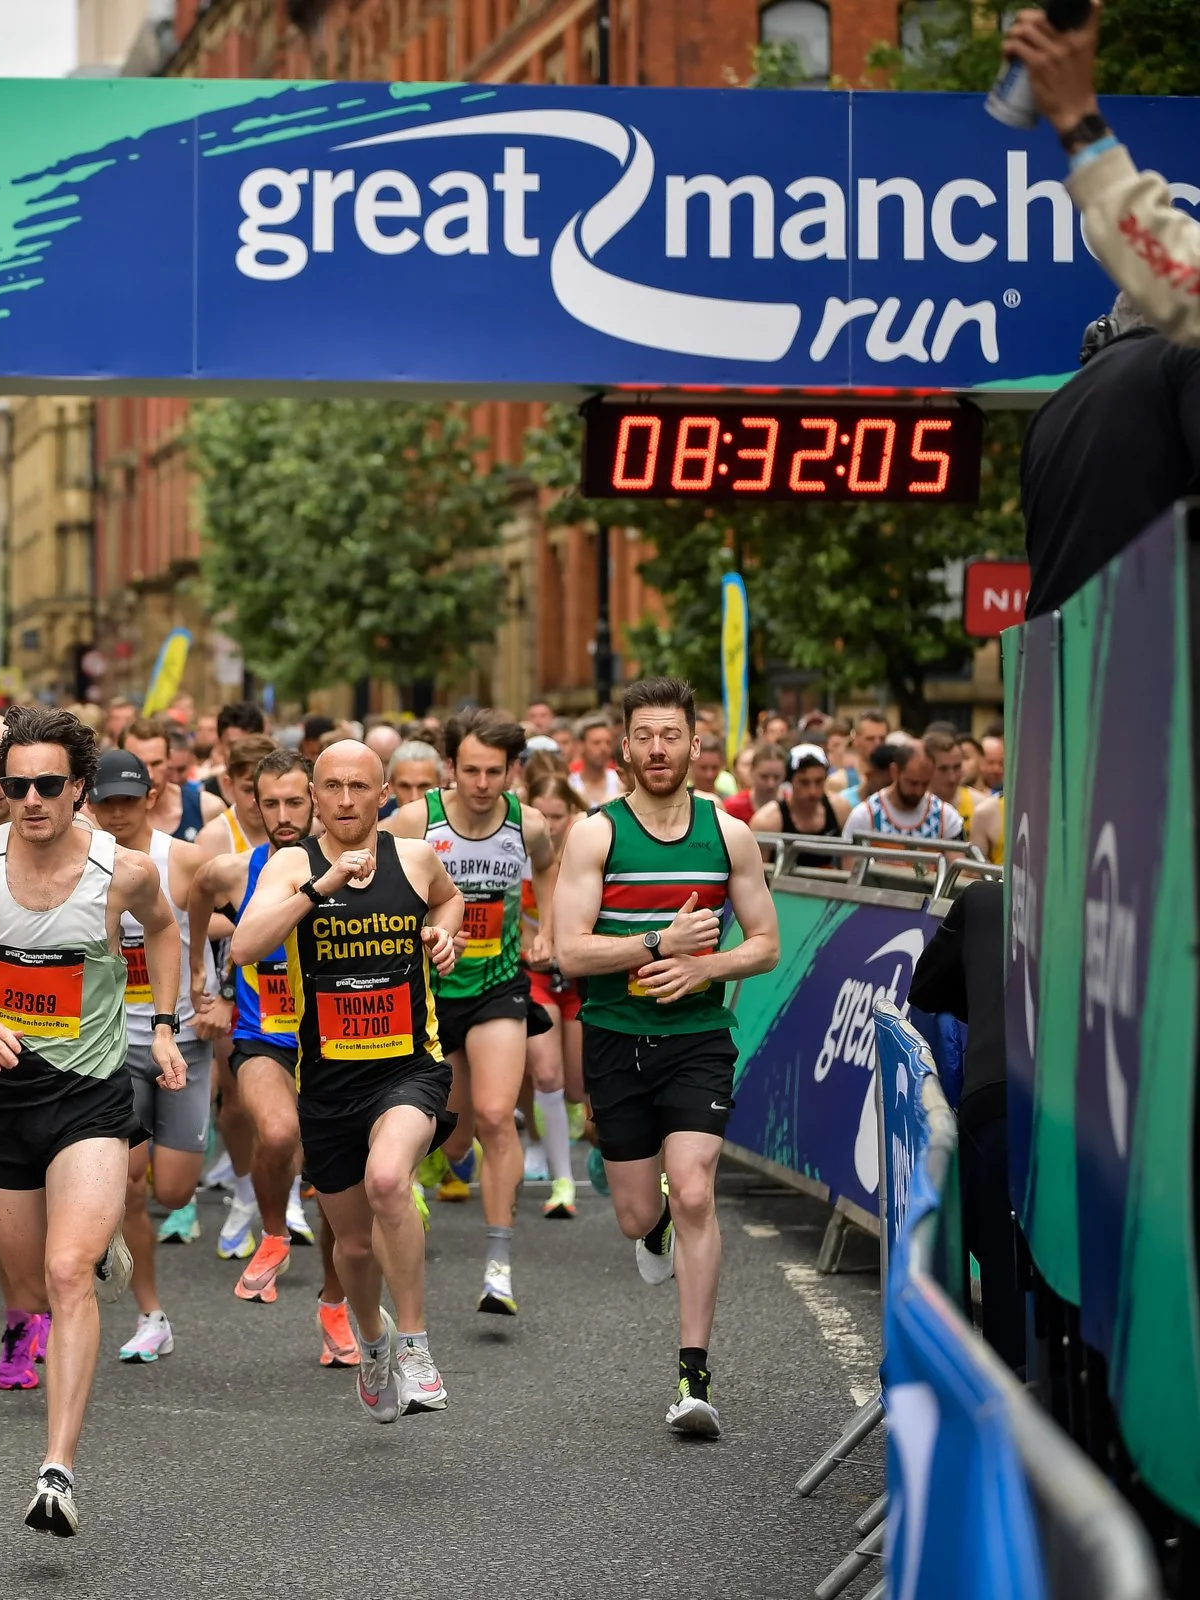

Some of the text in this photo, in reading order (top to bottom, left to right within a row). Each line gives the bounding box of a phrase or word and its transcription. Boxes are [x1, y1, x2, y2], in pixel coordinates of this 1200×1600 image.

[236, 147, 541, 281] great
[664, 150, 1200, 263] manch
[612, 416, 952, 492] 08:32:05
[983, 587, 1029, 612] NI
[460, 859, 491, 875] BRYN
[312, 913, 417, 938] Chorlton
[316, 938, 414, 961] Runners
[267, 979, 291, 994] MA
[355, 977, 390, 985] manchester
[4, 989, 57, 1014] 23369
[334, 994, 394, 1016] THOMAS
[342, 1016, 390, 1036] 21700
